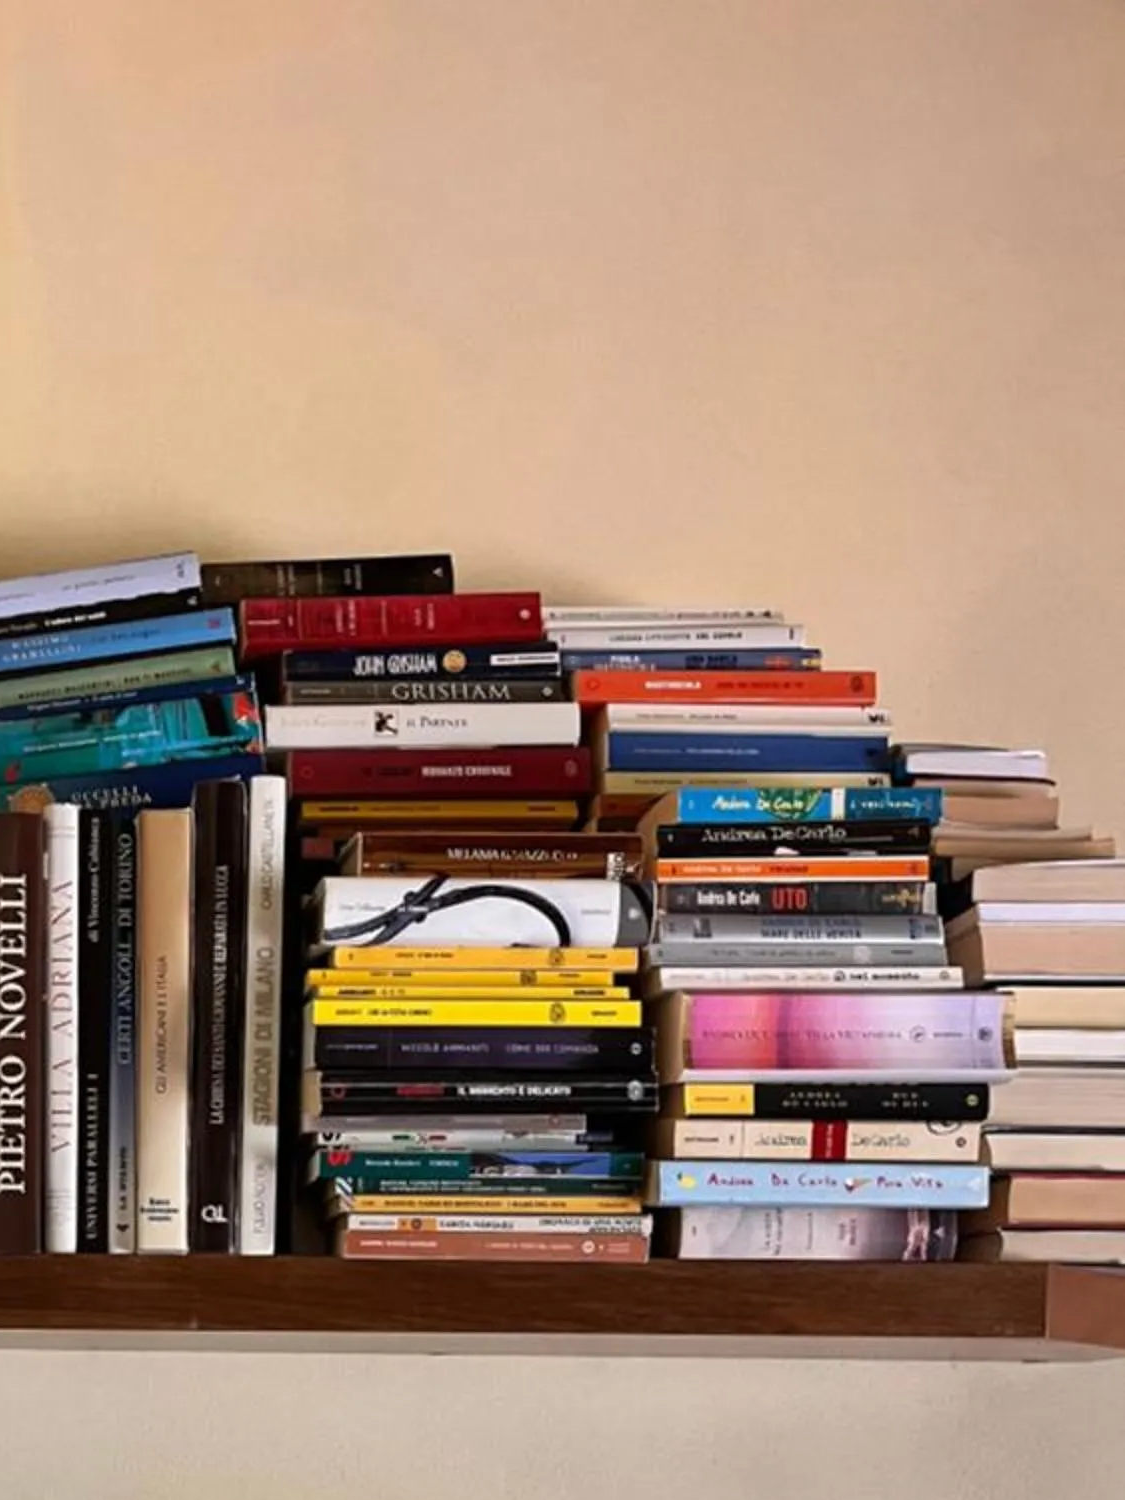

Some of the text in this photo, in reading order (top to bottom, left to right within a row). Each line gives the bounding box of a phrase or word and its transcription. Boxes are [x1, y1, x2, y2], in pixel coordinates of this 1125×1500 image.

[354, 653, 438, 676] JOHN GRISHAM
[391, 683, 511, 701] GRISHAM
[702, 826, 768, 843] Andrea
[116, 833, 133, 900] TORINO
[117, 908, 133, 927] DI
[770, 887, 810, 911] UTO
[50, 879, 74, 1154] VILLA ADRIANA
[116, 1015, 133, 1065] CERTI
[251, 946, 274, 1126] STAGIONI DI MILANO
[155, 1010, 168, 1074] AMERICANI
[86, 1086, 99, 1168] PARALLELI
[208, 1111, 225, 1125] LA
[86, 1171, 99, 1240] UNIVERSI
